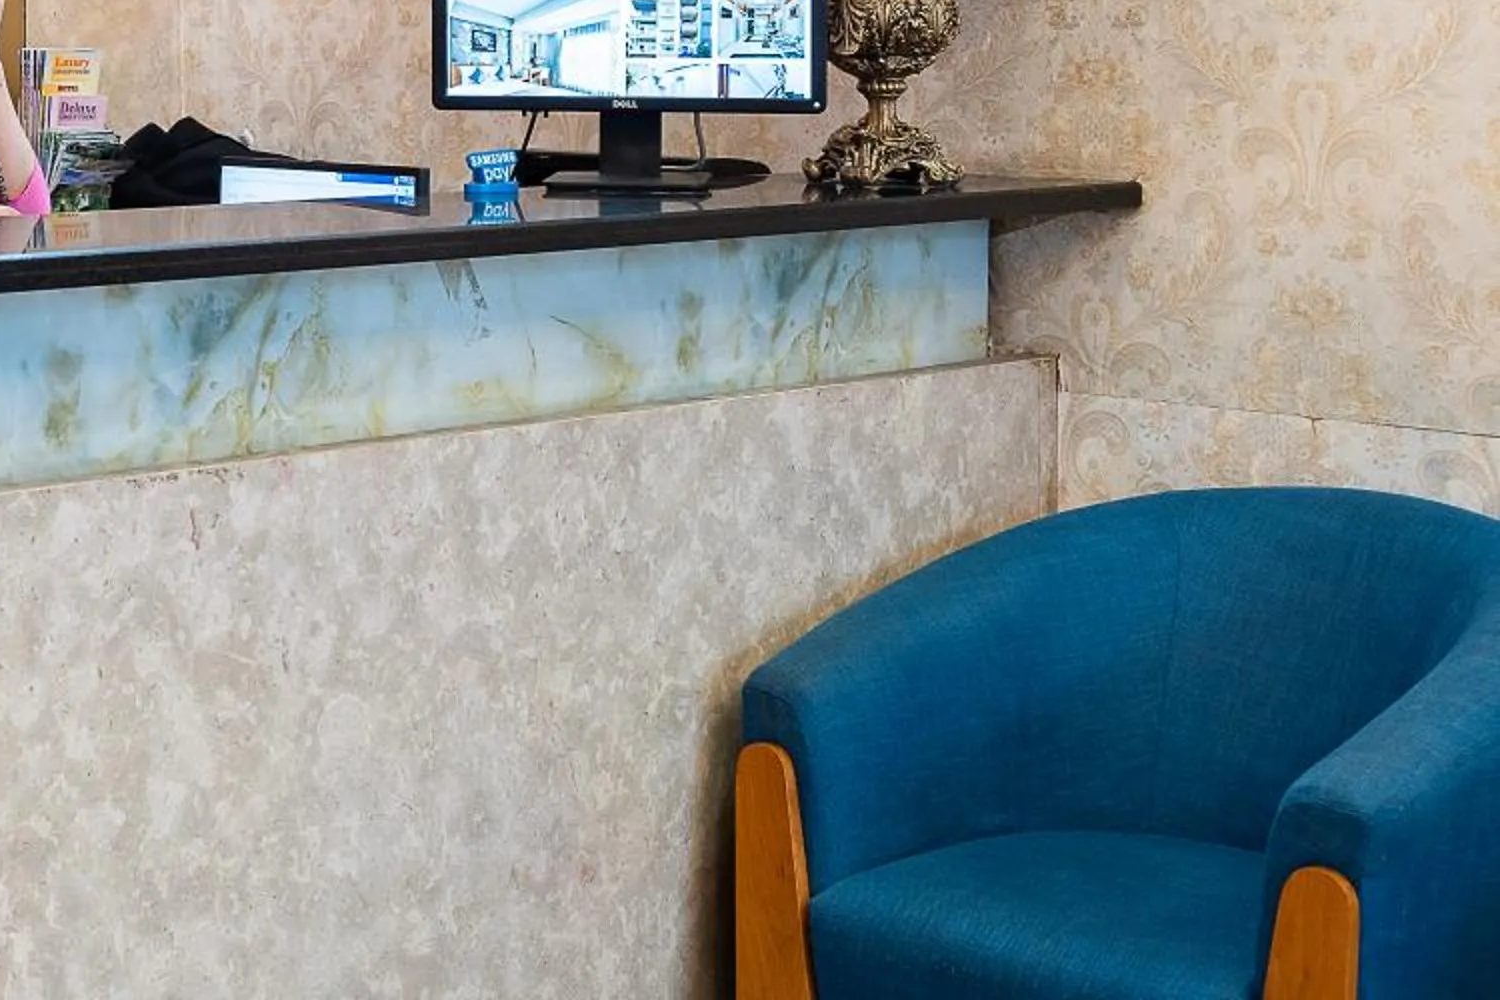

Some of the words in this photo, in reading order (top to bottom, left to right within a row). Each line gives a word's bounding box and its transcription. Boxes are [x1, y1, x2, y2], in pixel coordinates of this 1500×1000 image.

[612, 99, 638, 109] DELL
[470, 151, 517, 168] SAMSUNG
[483, 166, 509, 184] pay
